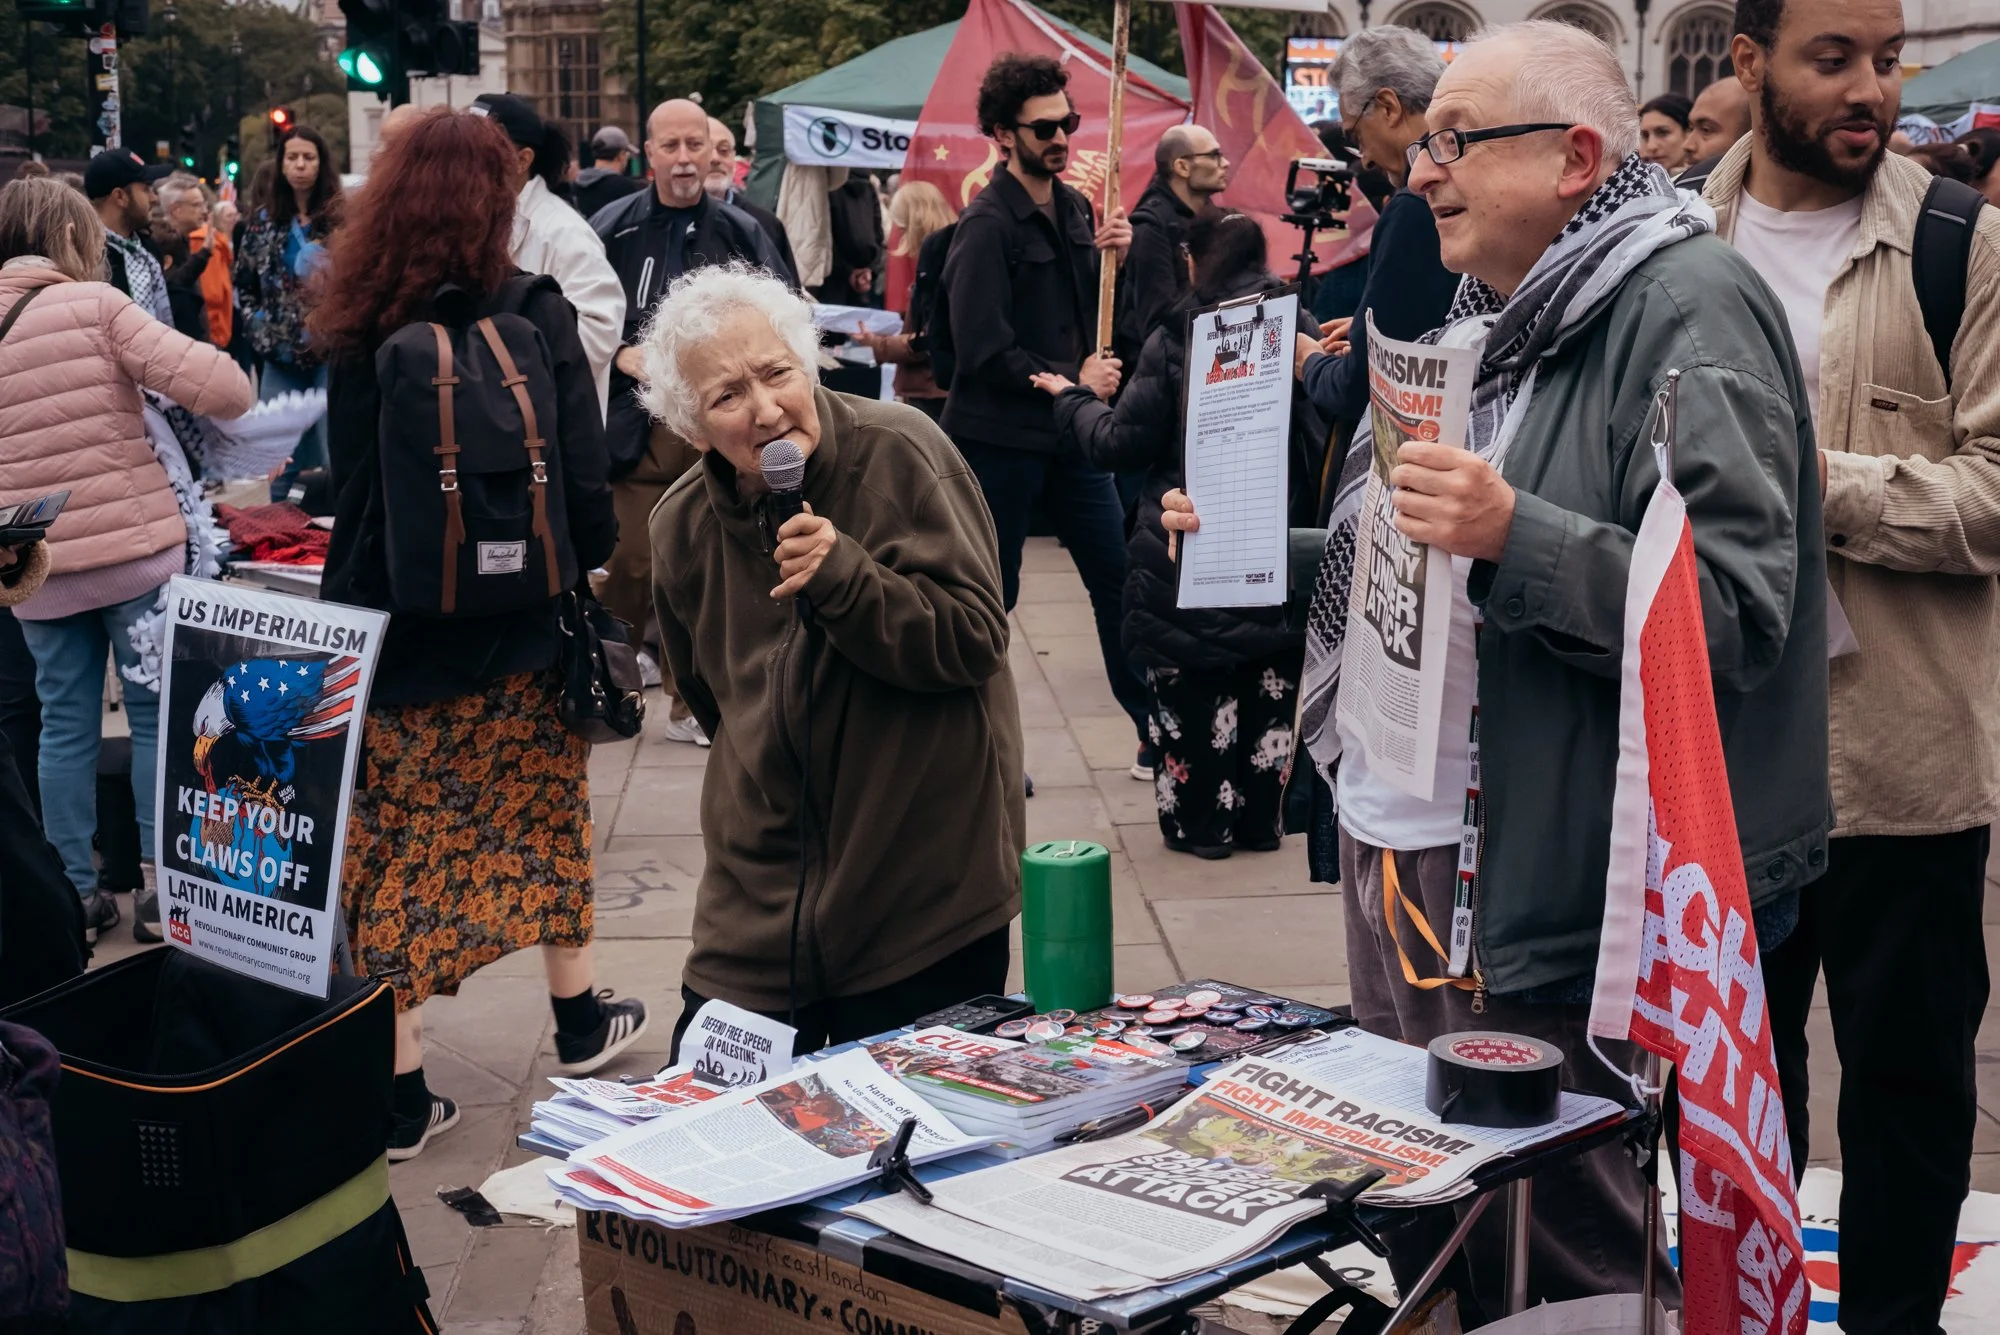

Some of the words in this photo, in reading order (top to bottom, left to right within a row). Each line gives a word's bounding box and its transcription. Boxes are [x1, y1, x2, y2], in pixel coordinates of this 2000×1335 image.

[861, 127, 911, 151] Sto
[178, 597, 208, 624] US
[211, 603, 368, 654] IMPERIALISM
[177, 785, 239, 824] KEEP
[245, 801, 315, 845] YOUR
[175, 833, 253, 878] CLAWS
[259, 856, 310, 891] OFF
[168, 875, 217, 912] LATIN
[221, 894, 314, 940] AMERICA
[170, 923, 190, 941] RCG
[194, 919, 245, 944] REVOLUTIONARY
[246, 937, 289, 956] COMMUNIST
[289, 950, 317, 964] GROUP
[198, 939, 311, 985] www.revolutionarycommunist.org
[701, 1016, 727, 1035] DEFEND
[725, 1025, 743, 1043] FREE
[743, 1032, 772, 1054] SPEECH
[704, 1035, 716, 1050] ON
[716, 1039, 756, 1065] PALESTINE
[916, 1034, 999, 1057] CUB
[843, 1079, 853, 1089] No
[852, 1087, 863, 1096] US
[863, 1096, 884, 1114] military
[865, 1083, 896, 1107] Hands
[895, 1106, 912, 1117] off
[1230, 1063, 1335, 1109] FIGHT
[1326, 1100, 1476, 1156] RACISM!
[1211, 1080, 1286, 1114] FIGHT
[1281, 1108, 1451, 1169] IMPERIALISM!
[1070, 1167, 1262, 1220] ATTACK
[586, 1209, 818, 1321] REVOLUTIONARY
